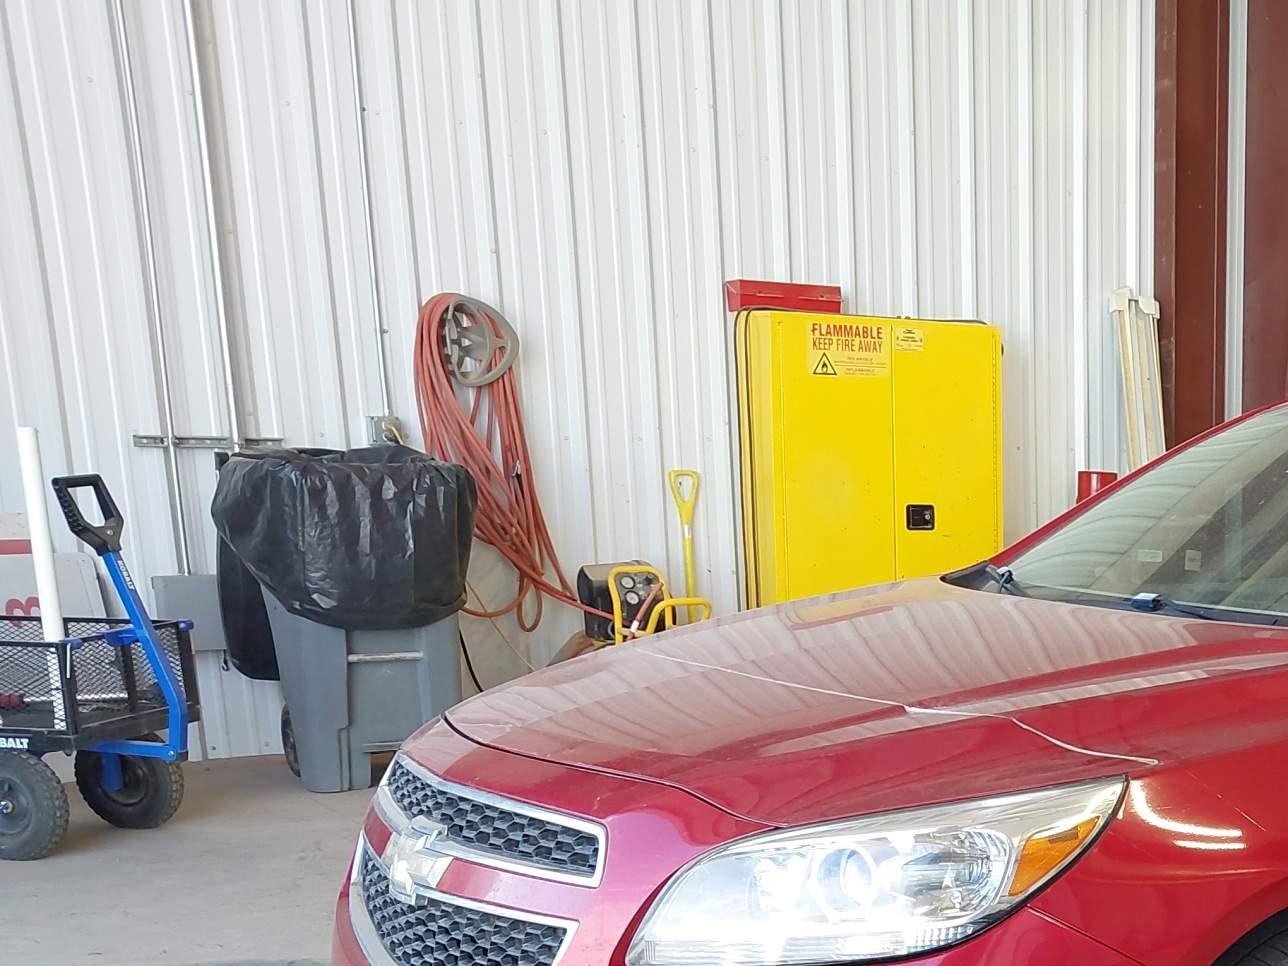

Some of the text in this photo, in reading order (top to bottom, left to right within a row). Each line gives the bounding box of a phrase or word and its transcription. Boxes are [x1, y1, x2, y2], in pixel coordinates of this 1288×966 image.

[812, 323, 883, 339] FLAMMABLE
[812, 338, 884, 353] KEEP FIRE AWAY
